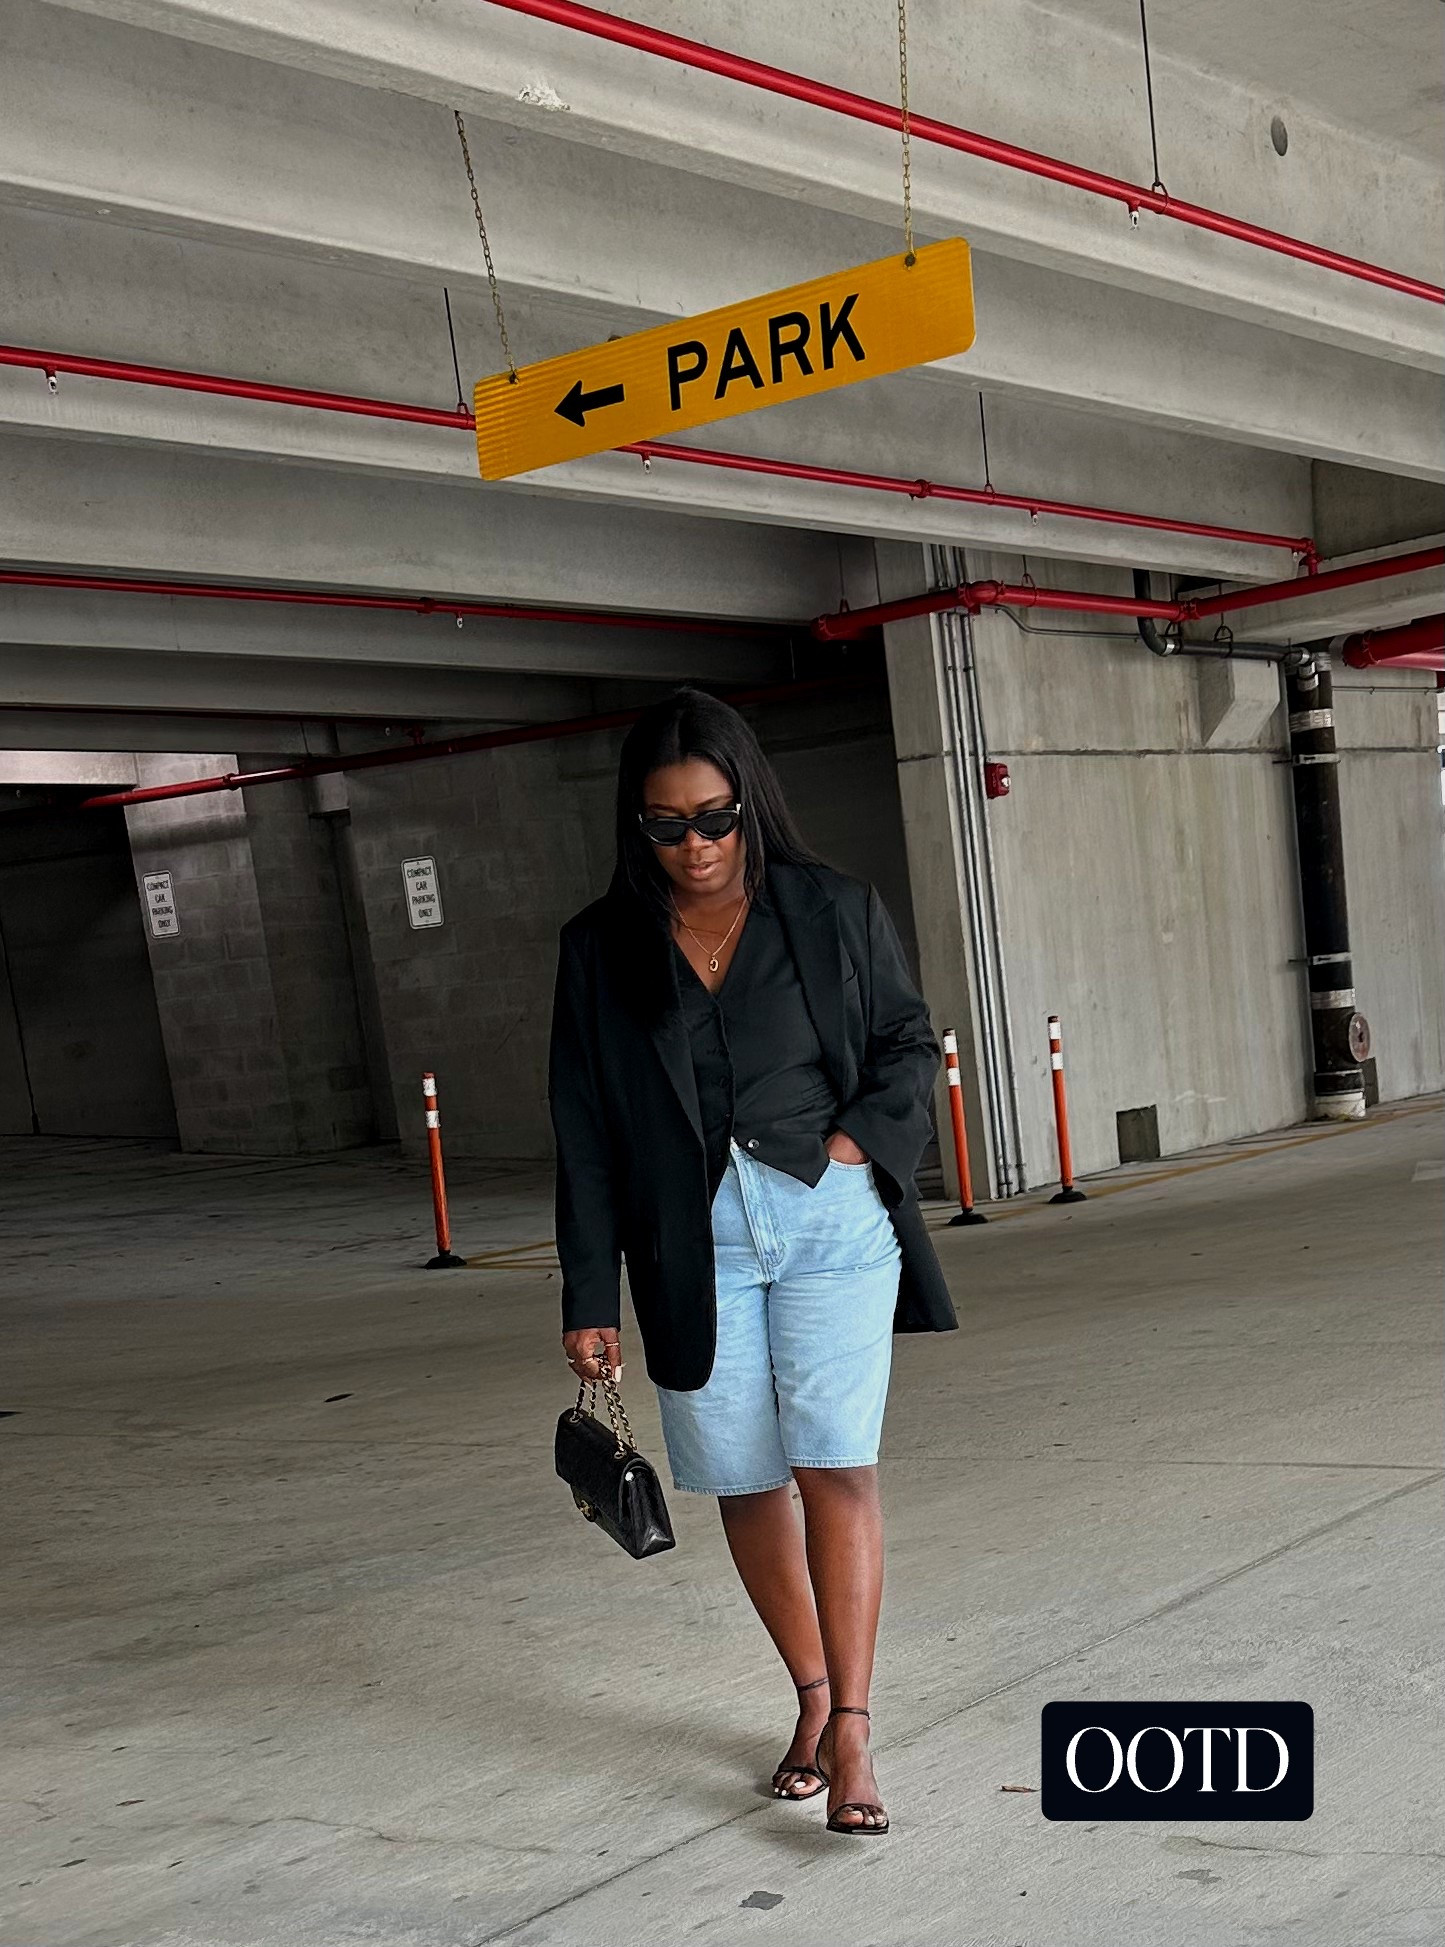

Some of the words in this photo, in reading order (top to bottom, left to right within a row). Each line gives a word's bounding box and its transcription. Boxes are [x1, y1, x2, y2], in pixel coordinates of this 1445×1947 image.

[667, 293, 866, 412] PARK
[407, 866, 432, 878] COMPACT
[416, 881, 427, 891] CAR
[412, 893, 435, 905] PARKING
[418, 908, 432, 918] ONLY
